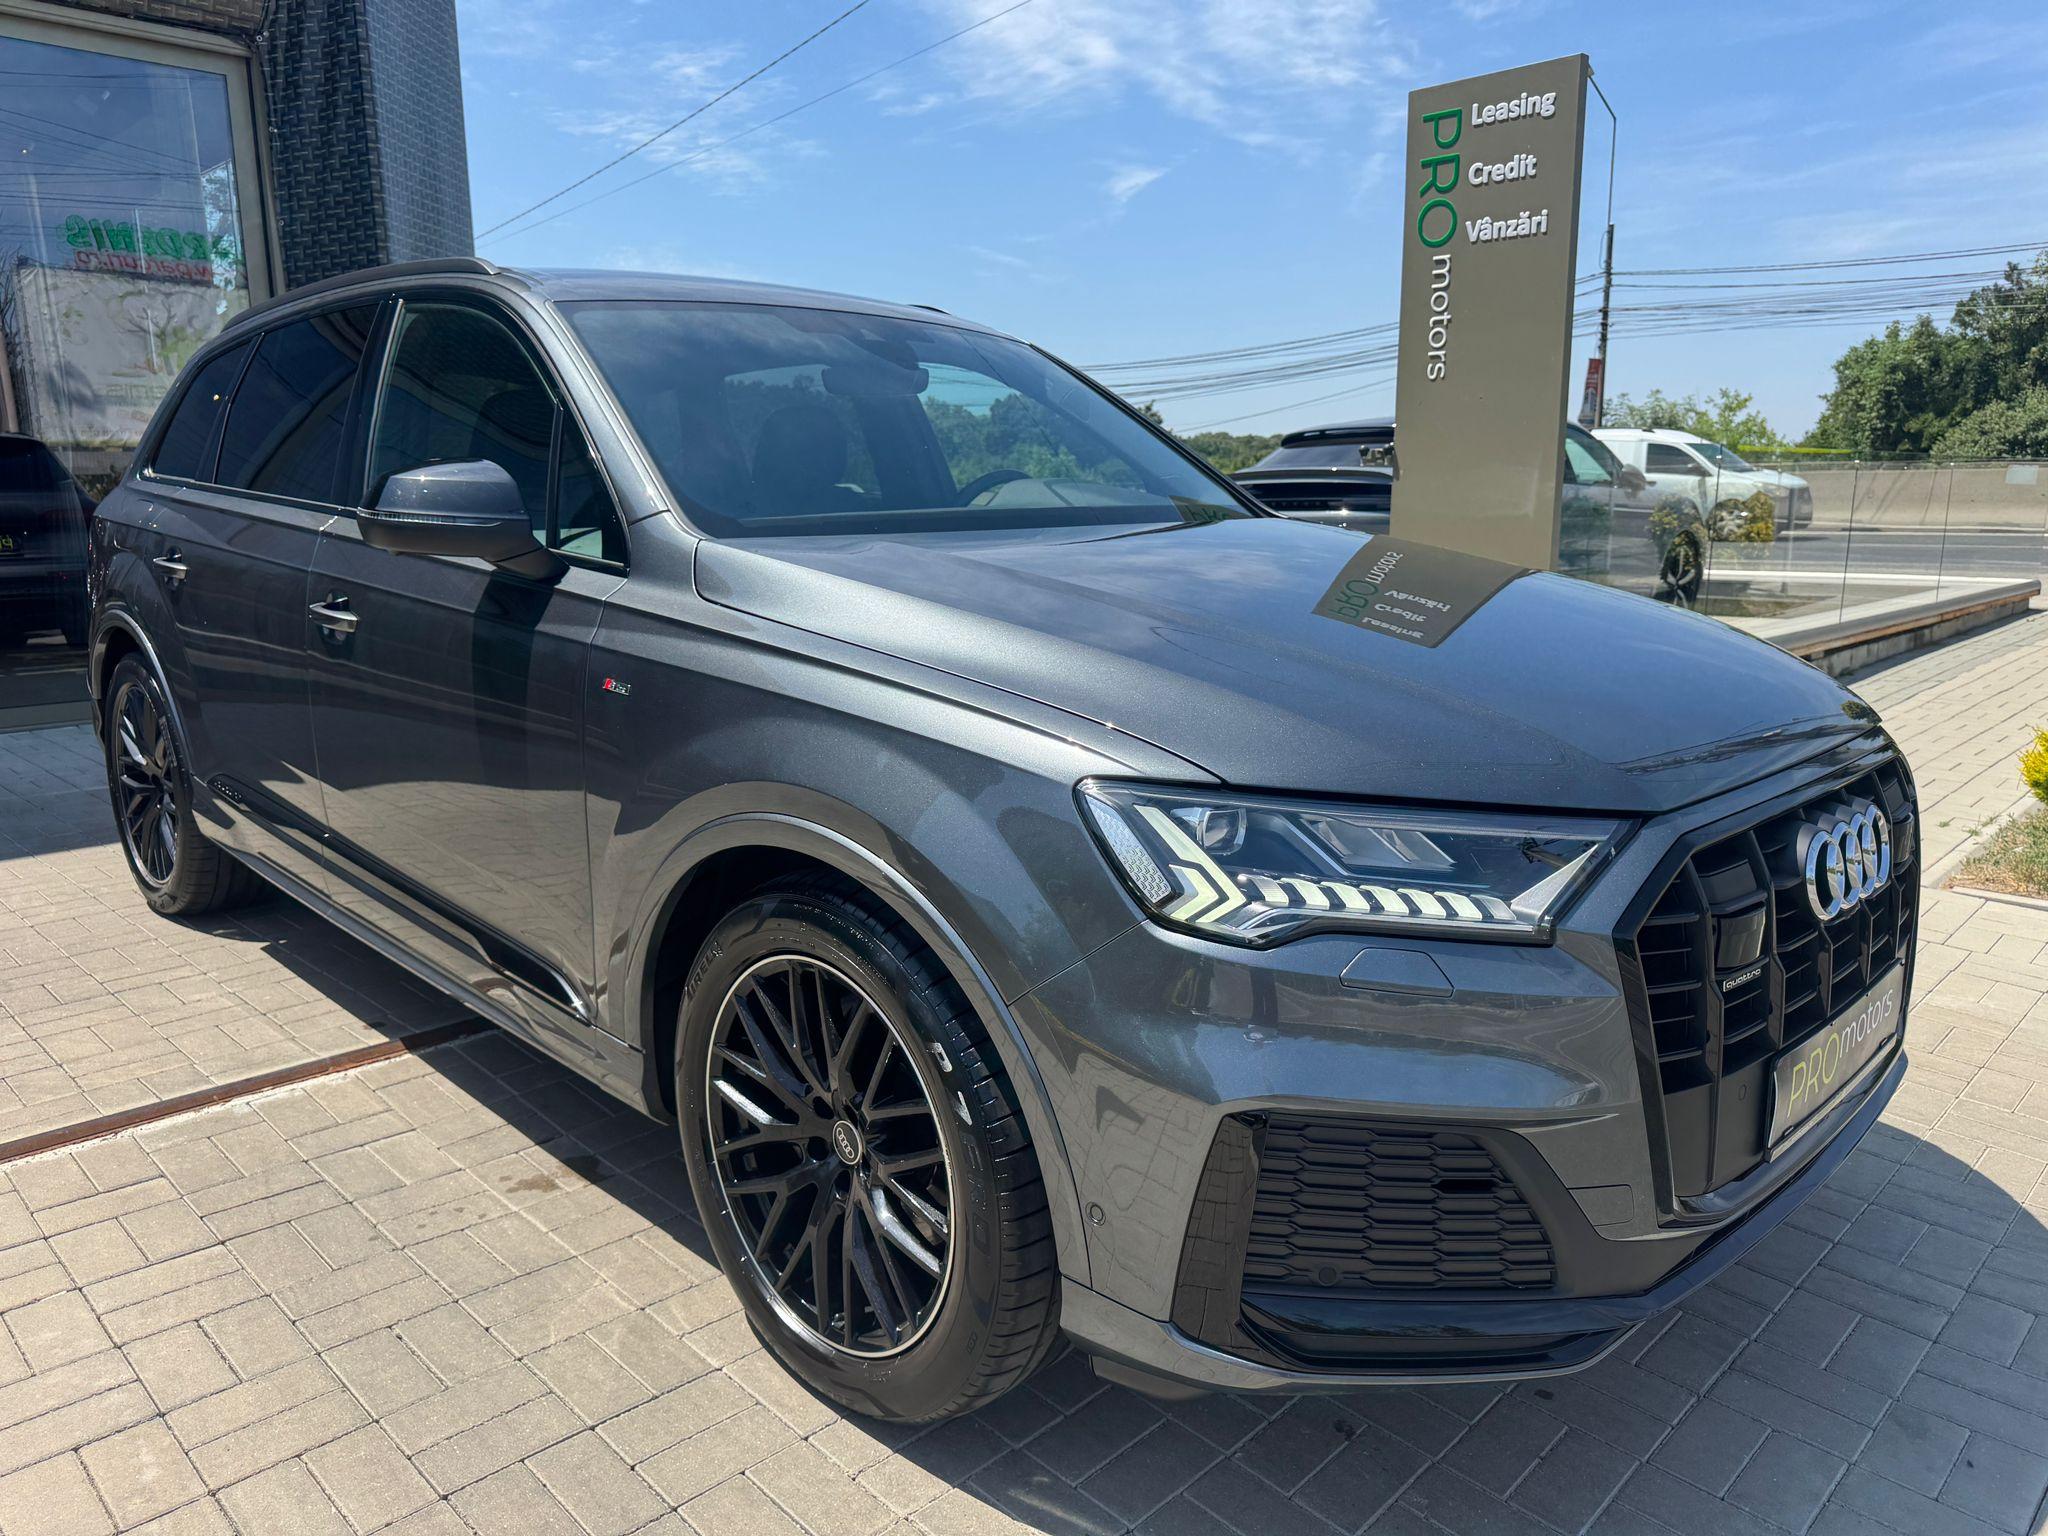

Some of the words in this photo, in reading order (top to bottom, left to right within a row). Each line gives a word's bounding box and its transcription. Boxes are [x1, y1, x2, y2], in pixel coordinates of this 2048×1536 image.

[1471, 92, 1556, 126] Leasing
[1468, 153, 1538, 186] Credit
[1465, 209, 1548, 242] Vânzări
[1726, 968, 1761, 988] quattro
